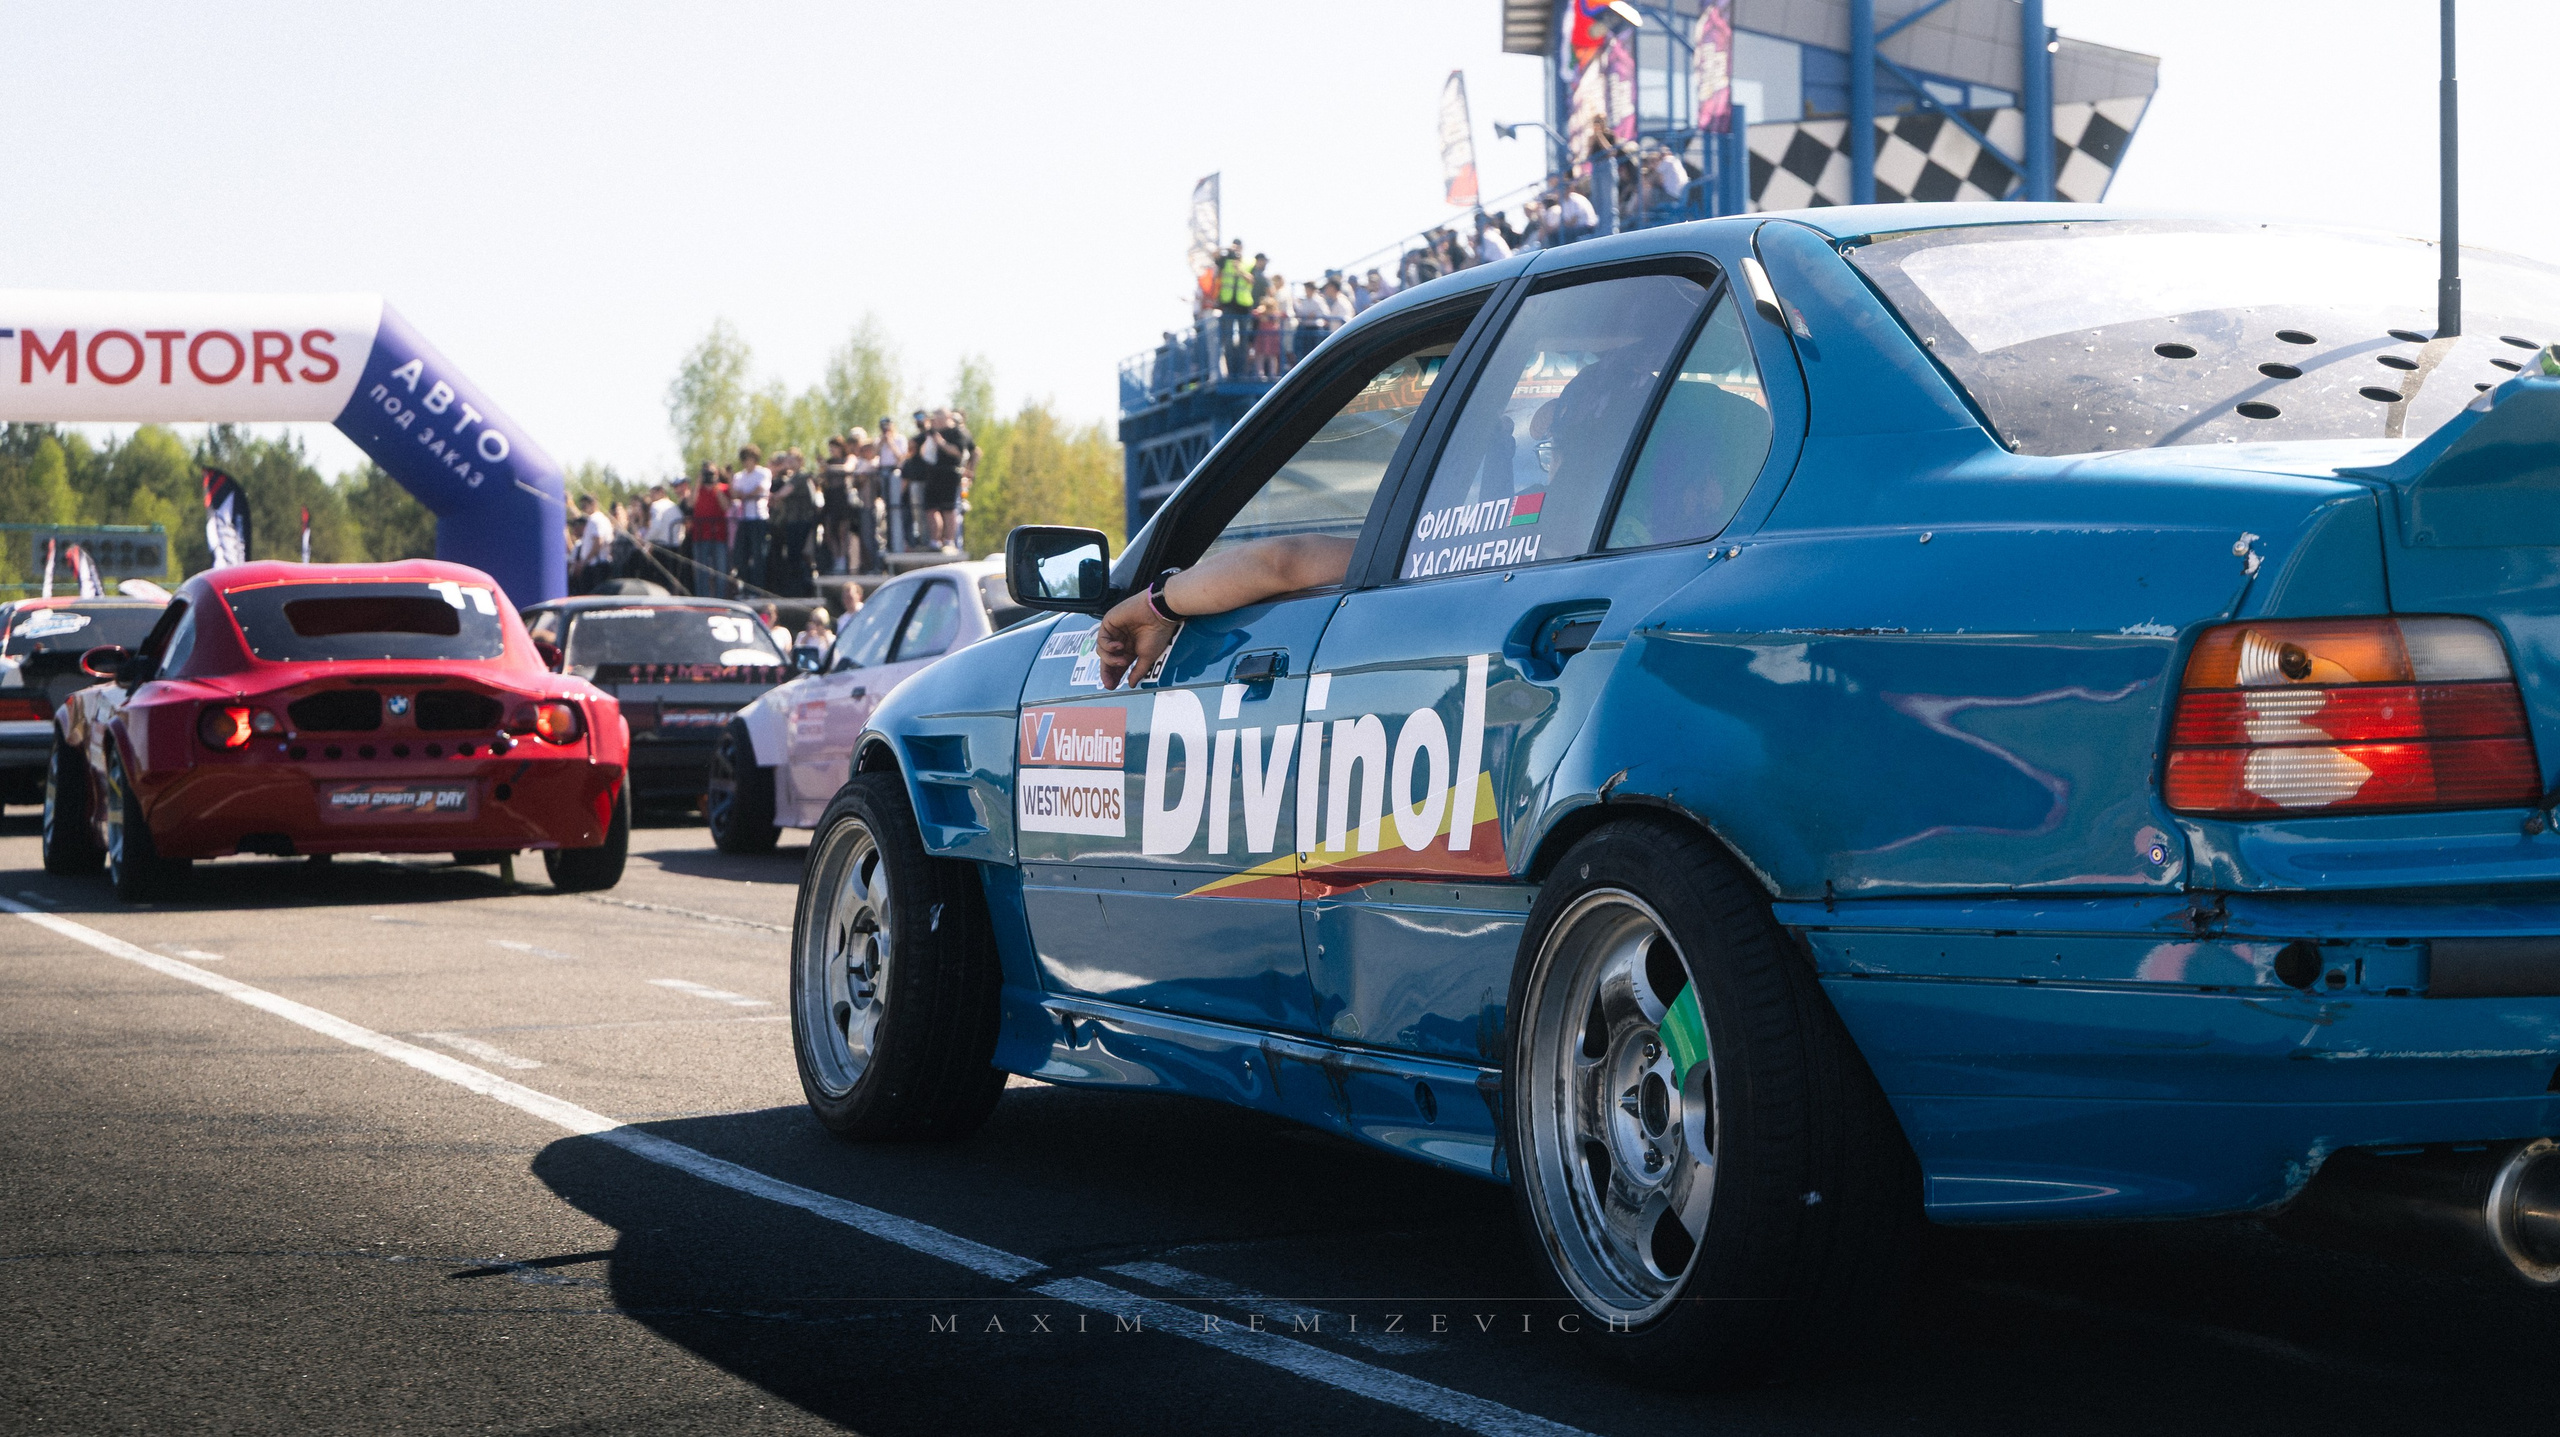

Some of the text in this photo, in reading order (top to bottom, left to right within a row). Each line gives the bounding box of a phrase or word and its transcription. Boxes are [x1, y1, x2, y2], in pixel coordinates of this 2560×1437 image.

[390, 358, 510, 463] АВТО
[369, 383, 485, 488] ПОД ЗАКАЗ
[1417, 498, 1510, 542] ФИЛИПП
[1409, 534, 1542, 579] ХАСИНЕВИЧ
[1053, 728, 1124, 763] Valvoline
[1142, 654, 1489, 855] Divinol
[1023, 785, 1121, 820] WESTMOTORS
